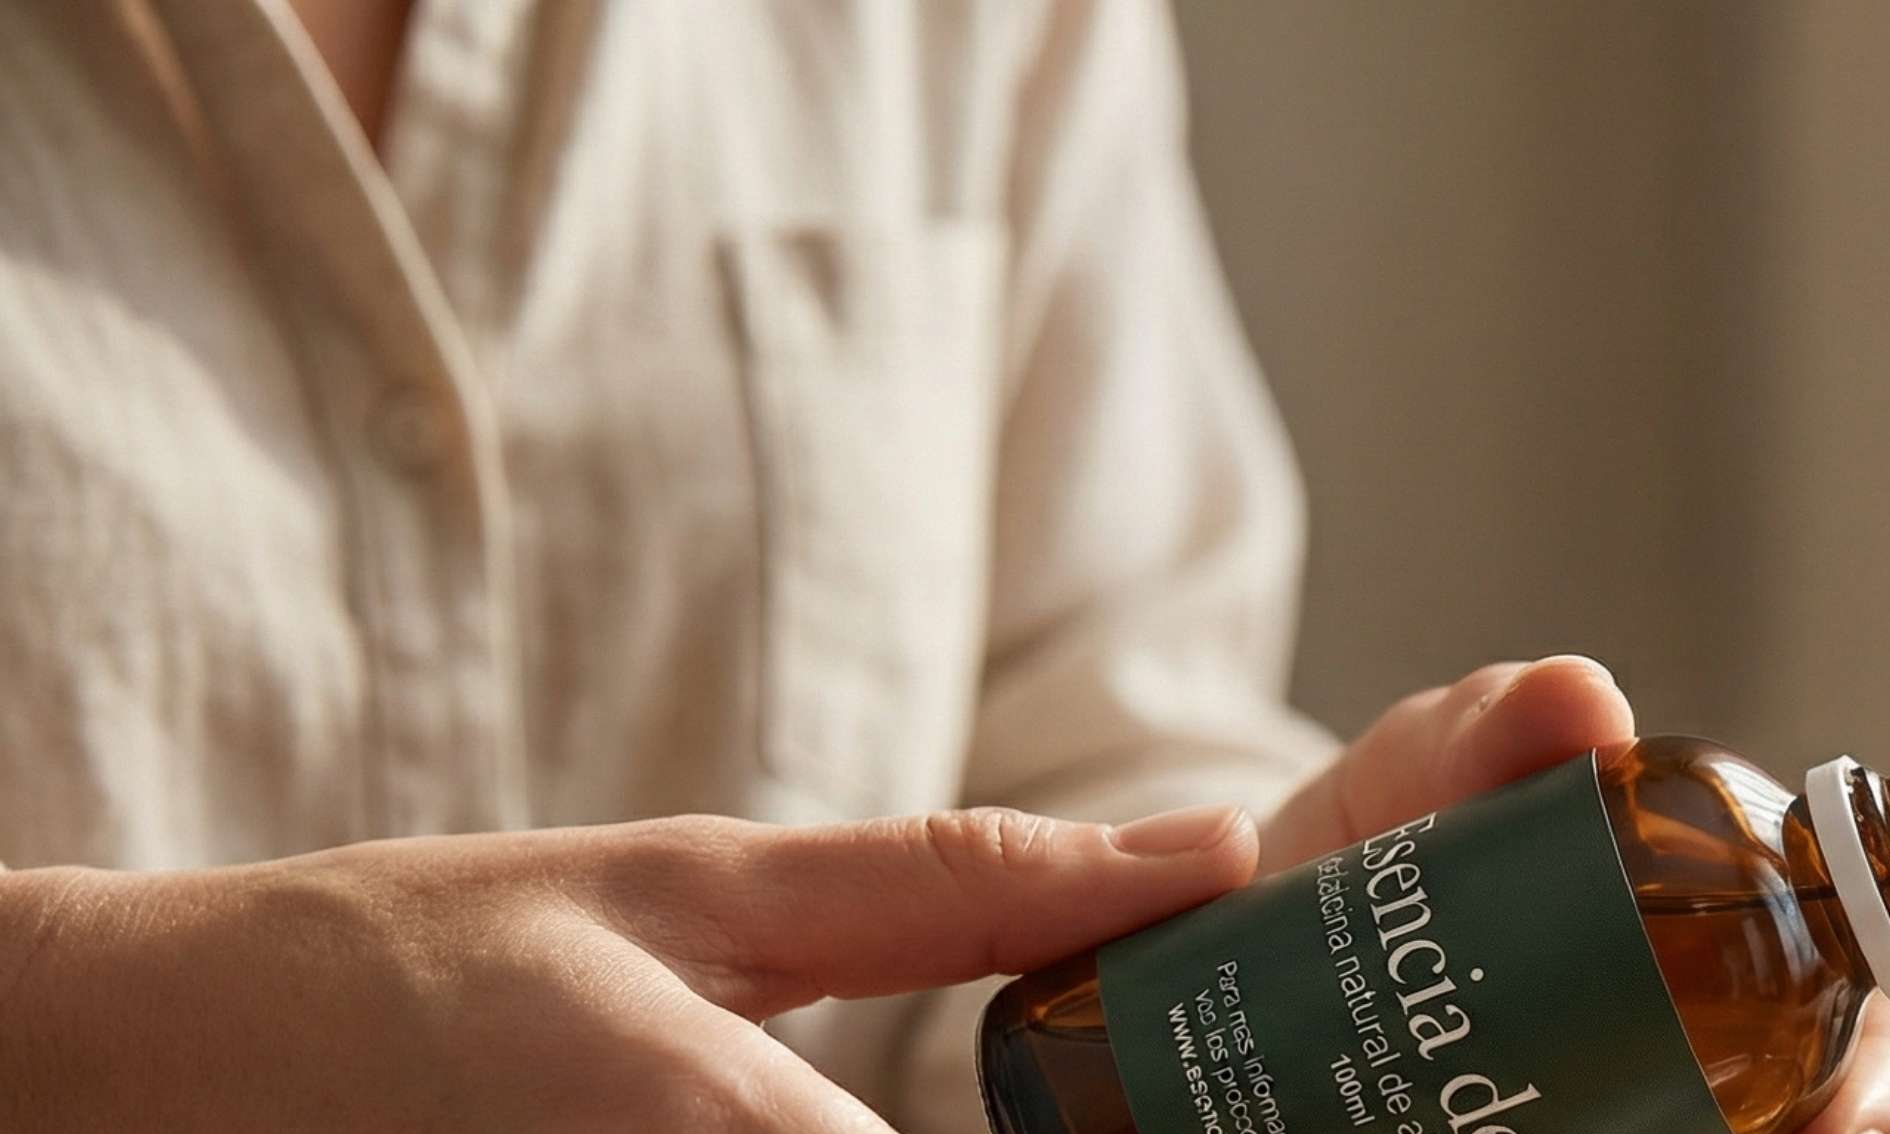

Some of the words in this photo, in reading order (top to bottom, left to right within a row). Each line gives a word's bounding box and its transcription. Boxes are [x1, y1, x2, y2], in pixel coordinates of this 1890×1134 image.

[1361, 812, 1484, 1060] Esencia
[1217, 961, 1240, 1008] Para
[1205, 1027, 1229, 1062] los
[1335, 956, 1401, 1068] natural
[1378, 1074, 1413, 1114] de
[1331, 1054, 1375, 1126] 100ml
